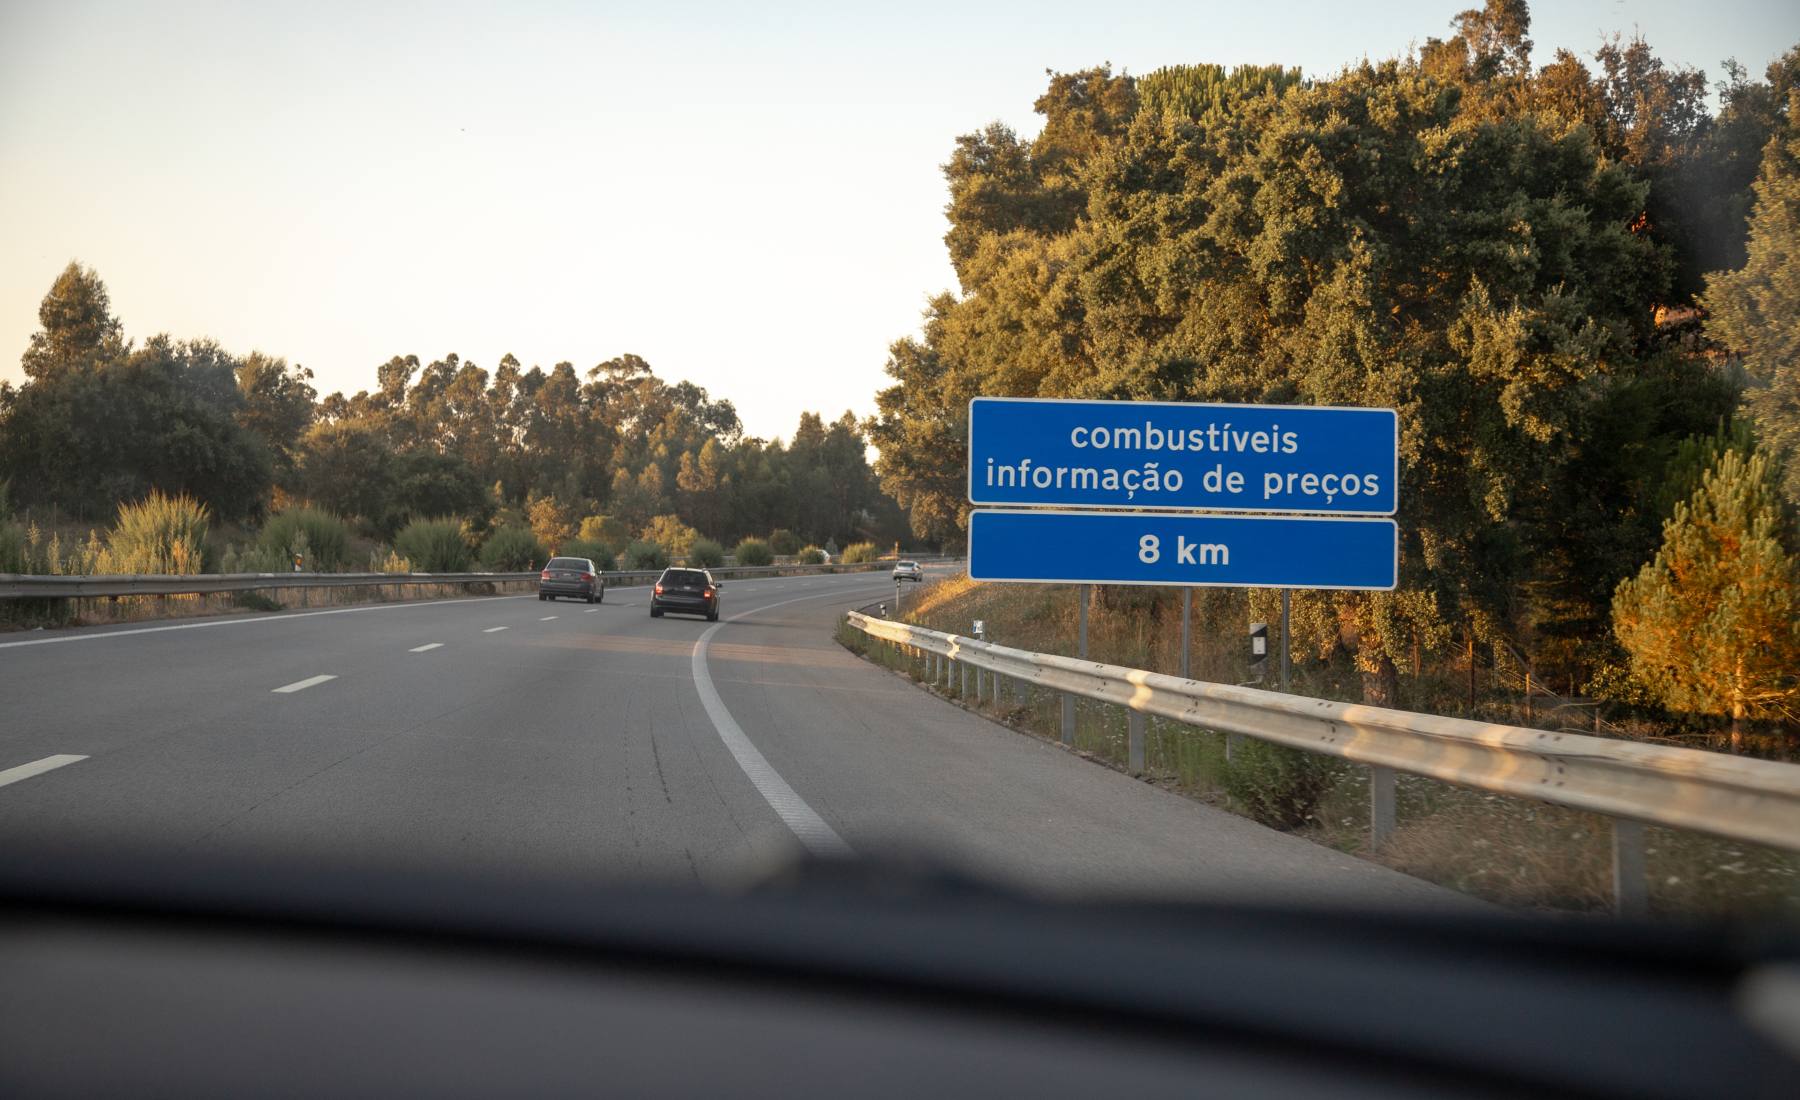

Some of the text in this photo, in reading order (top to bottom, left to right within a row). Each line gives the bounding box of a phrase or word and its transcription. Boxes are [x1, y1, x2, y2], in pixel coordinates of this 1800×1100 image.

[1071, 421, 1298, 454] combustíveis
[987, 457, 1381, 505] informação de preços
[1138, 534, 1230, 566] 8 km
